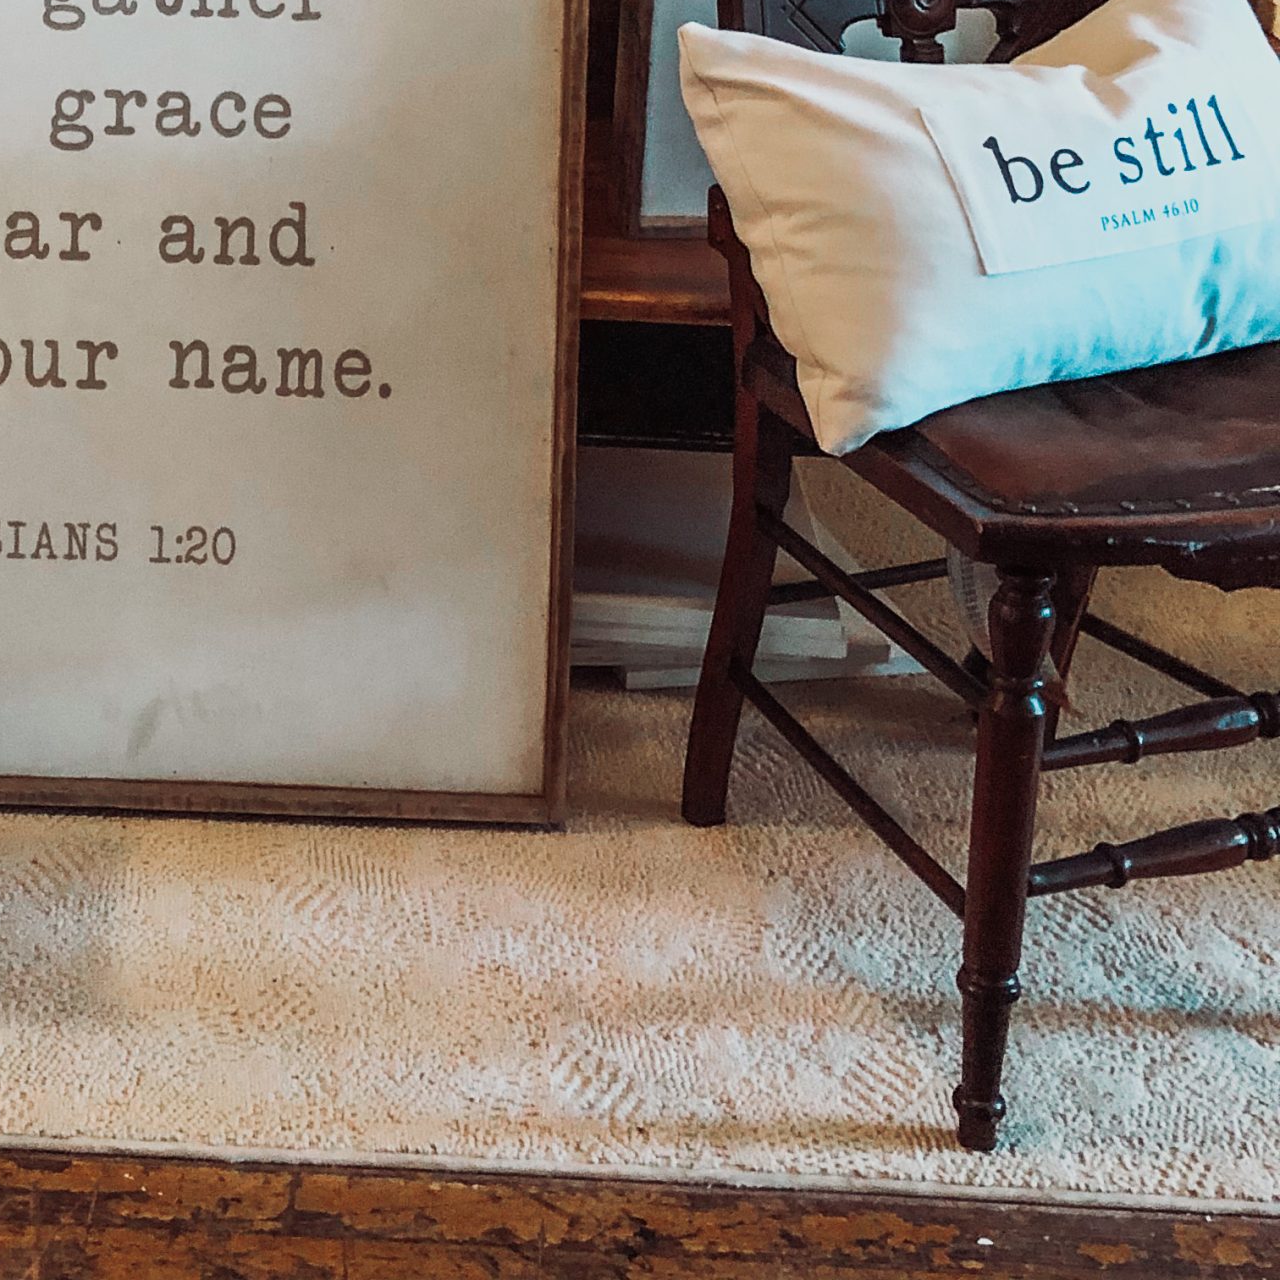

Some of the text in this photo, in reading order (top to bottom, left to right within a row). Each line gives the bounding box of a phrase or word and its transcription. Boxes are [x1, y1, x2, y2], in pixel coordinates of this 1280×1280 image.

[49, 85, 293, 151] grace
[983, 94, 1246, 204] be still
[158, 202, 315, 268] and
[1100, 206, 1157, 232] PSALM
[168, 337, 394, 399] name.
[148, 525, 237, 566] 1:20
